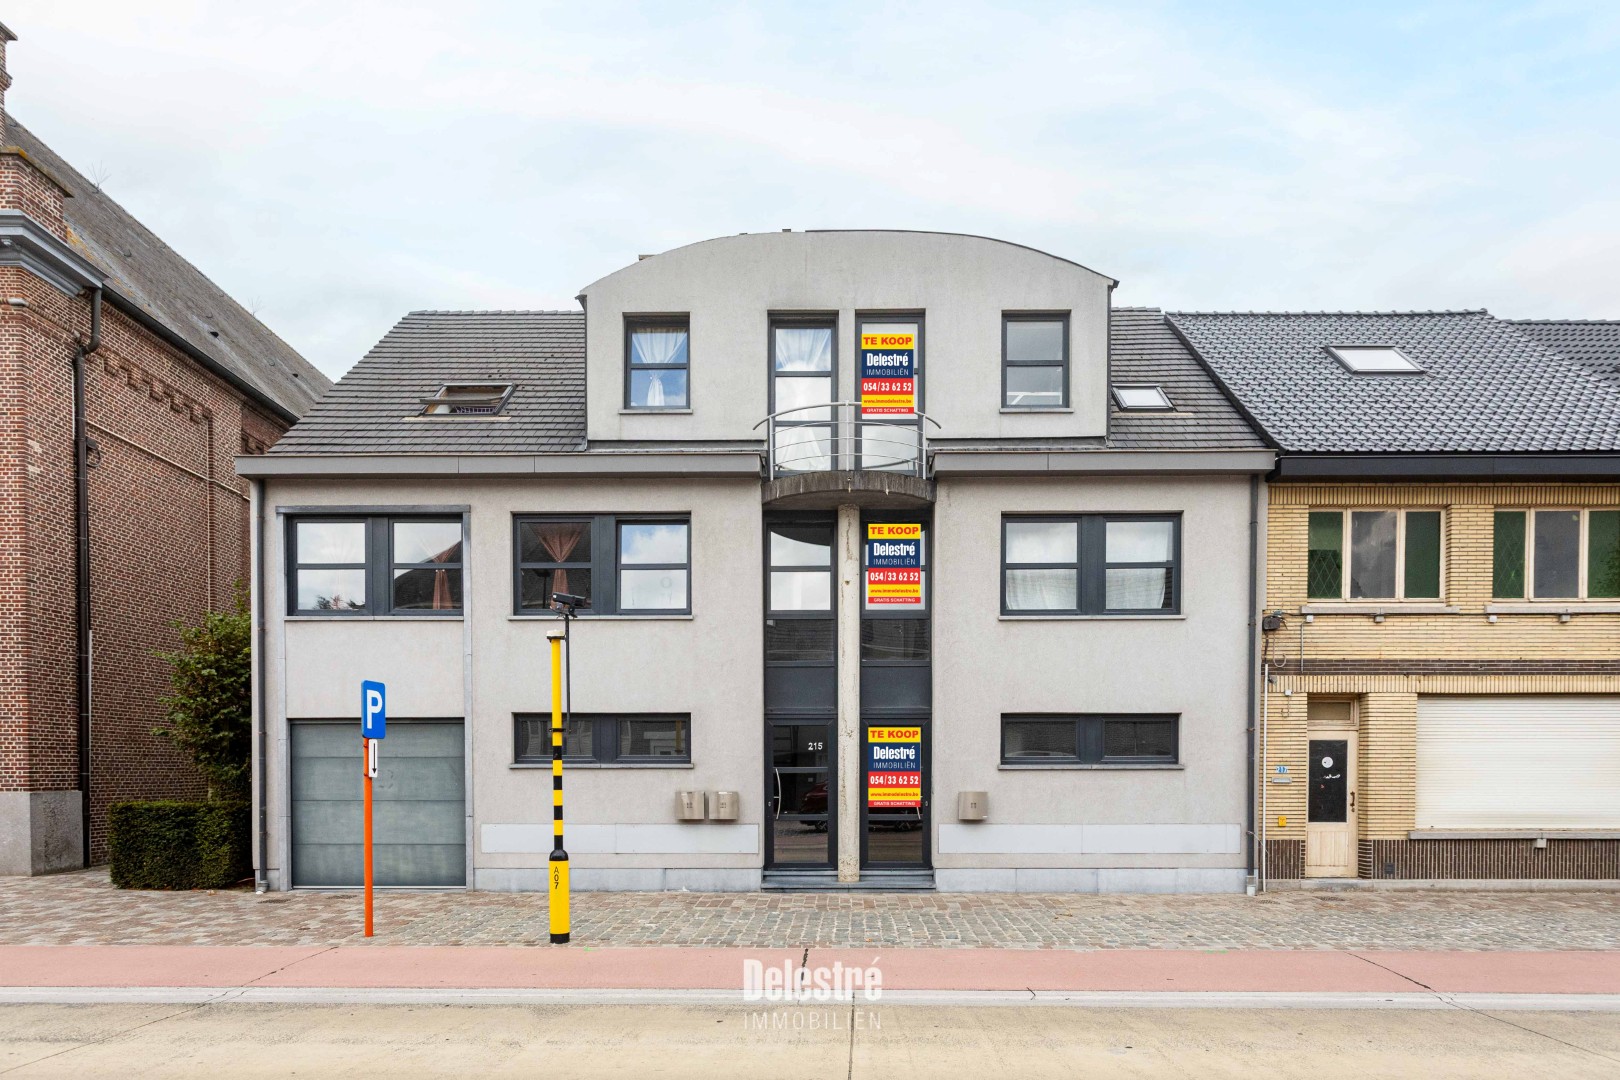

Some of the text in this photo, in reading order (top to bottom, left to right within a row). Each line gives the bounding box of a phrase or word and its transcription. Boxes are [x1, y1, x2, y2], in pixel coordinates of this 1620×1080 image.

[863, 337, 912, 345] TE KOOP
[866, 352, 909, 366] Delestré
[866, 368, 909, 376] IMMOBILIËN
[863, 382, 912, 392] 054/33 62 52
[870, 527, 919, 535] TE KOOP
[873, 542, 916, 556] Delestré
[873, 558, 916, 566] IMMOBILIËN
[870, 571, 919, 582] 054/33 62 52
[366, 689, 383, 729] P
[870, 730, 919, 738] TE KOOP
[808, 742, 823, 750] 215
[873, 745, 916, 760] Delestré
[873, 761, 916, 769] IMMOBILIËN
[870, 775, 919, 785] 054/33 62 52
